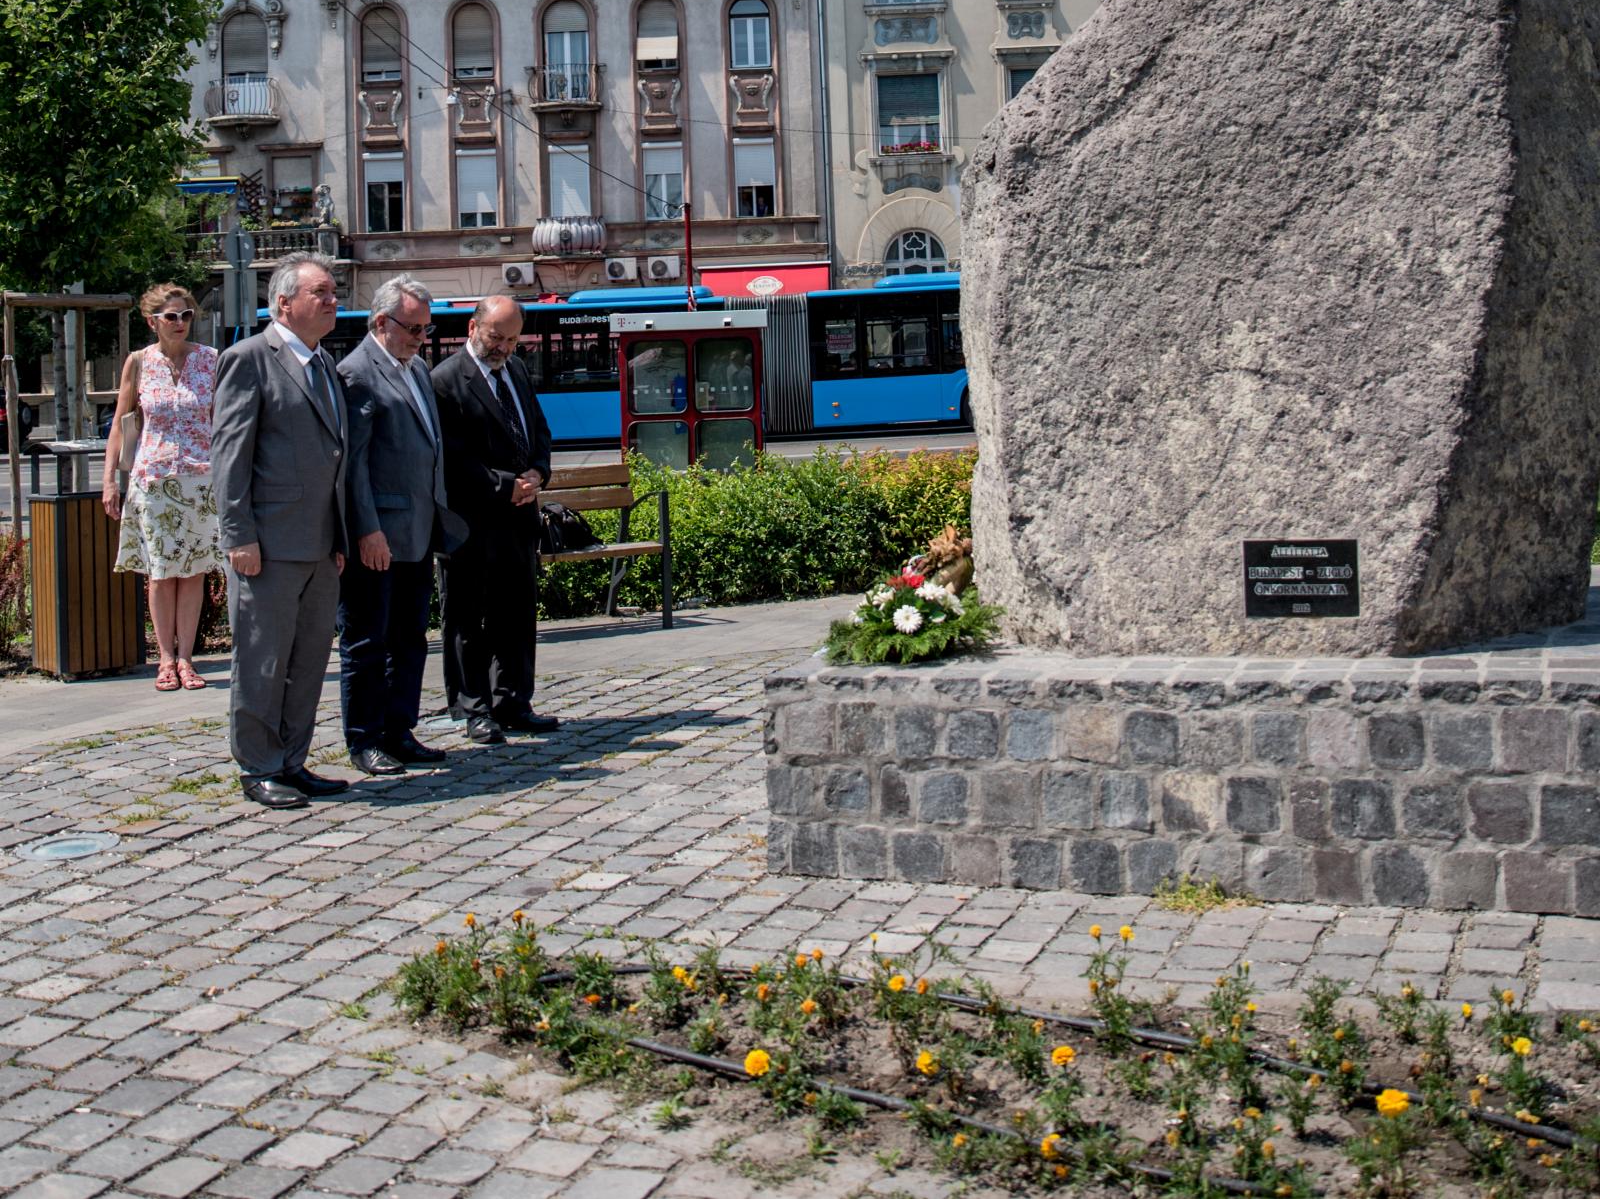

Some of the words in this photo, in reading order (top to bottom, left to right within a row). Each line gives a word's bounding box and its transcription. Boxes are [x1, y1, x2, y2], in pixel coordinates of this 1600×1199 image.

[1248, 567, 1304, 579] BUDAPEST
[1317, 564, 1353, 579] ZUGLÓ
[1253, 582, 1349, 595] ÖNKORMÁNYZATA
